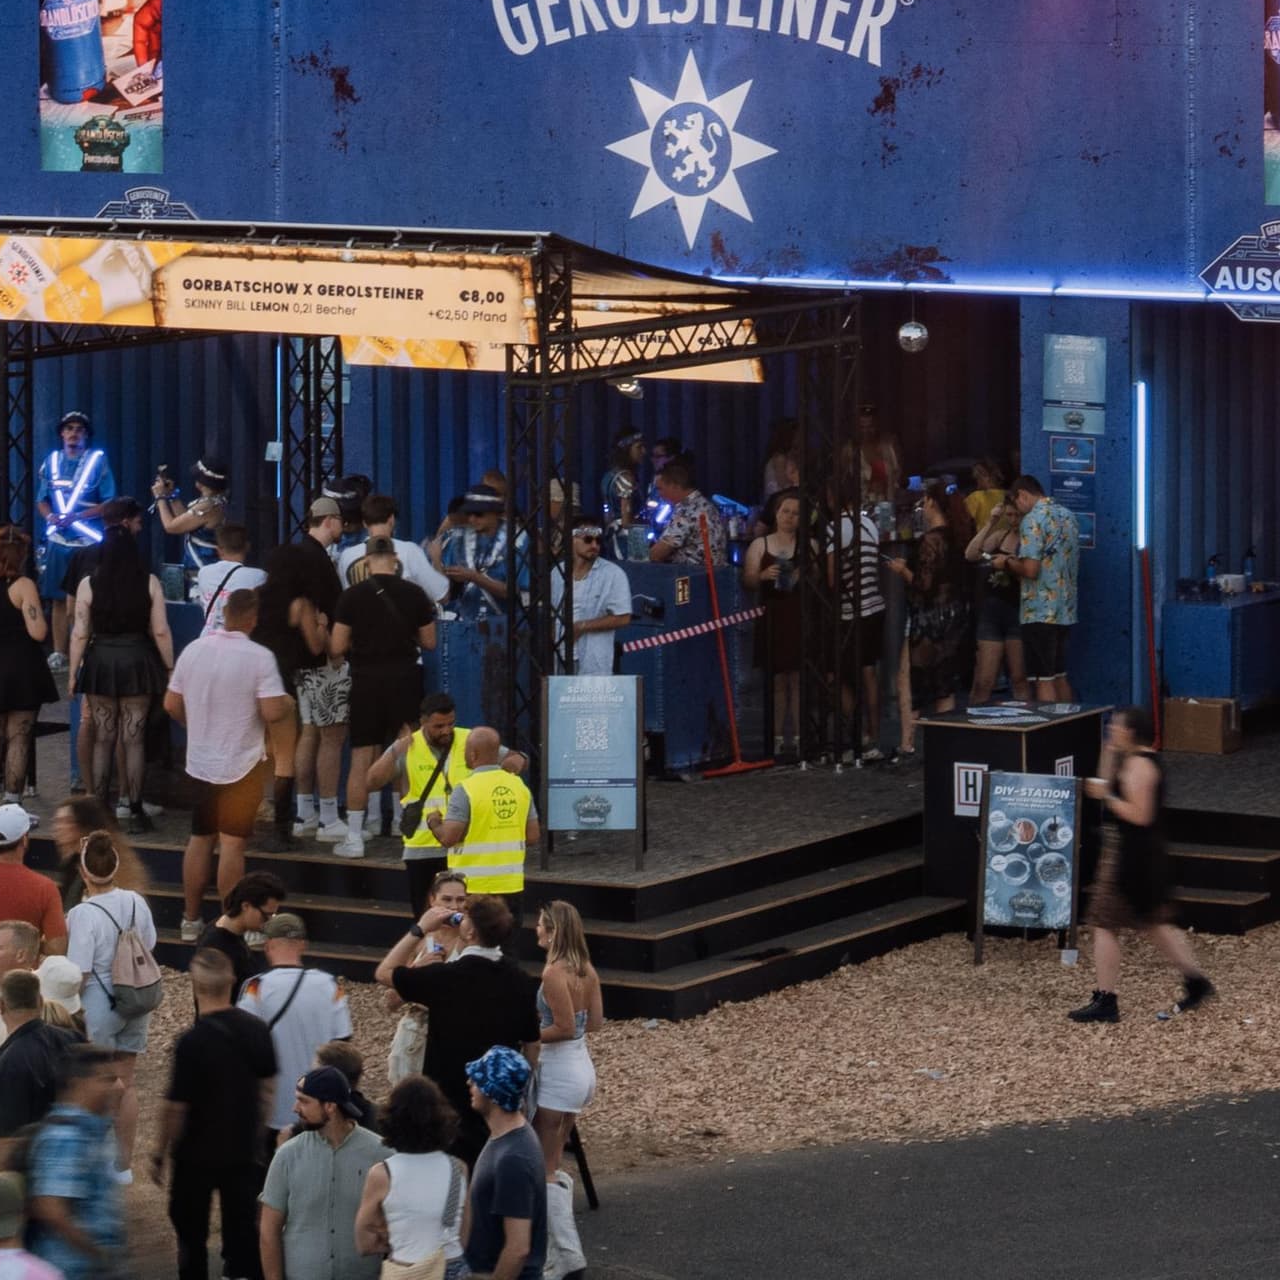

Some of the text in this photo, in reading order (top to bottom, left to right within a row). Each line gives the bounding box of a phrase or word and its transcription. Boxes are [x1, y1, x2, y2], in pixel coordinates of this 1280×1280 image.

[183, 278, 424, 301] GORBATSCHOW X GEROLSTEINER
[459, 290, 505, 304] €8,00
[184, 298, 222, 310] SKINNY
[227, 300, 246, 311] BILL
[250, 302, 290, 312] LEMON
[316, 304, 357, 316] Becher
[428, 310, 508, 323] +€2,50 Pfand
[964, 771, 977, 802] H
[993, 786, 1071, 799] DIY-STATION
